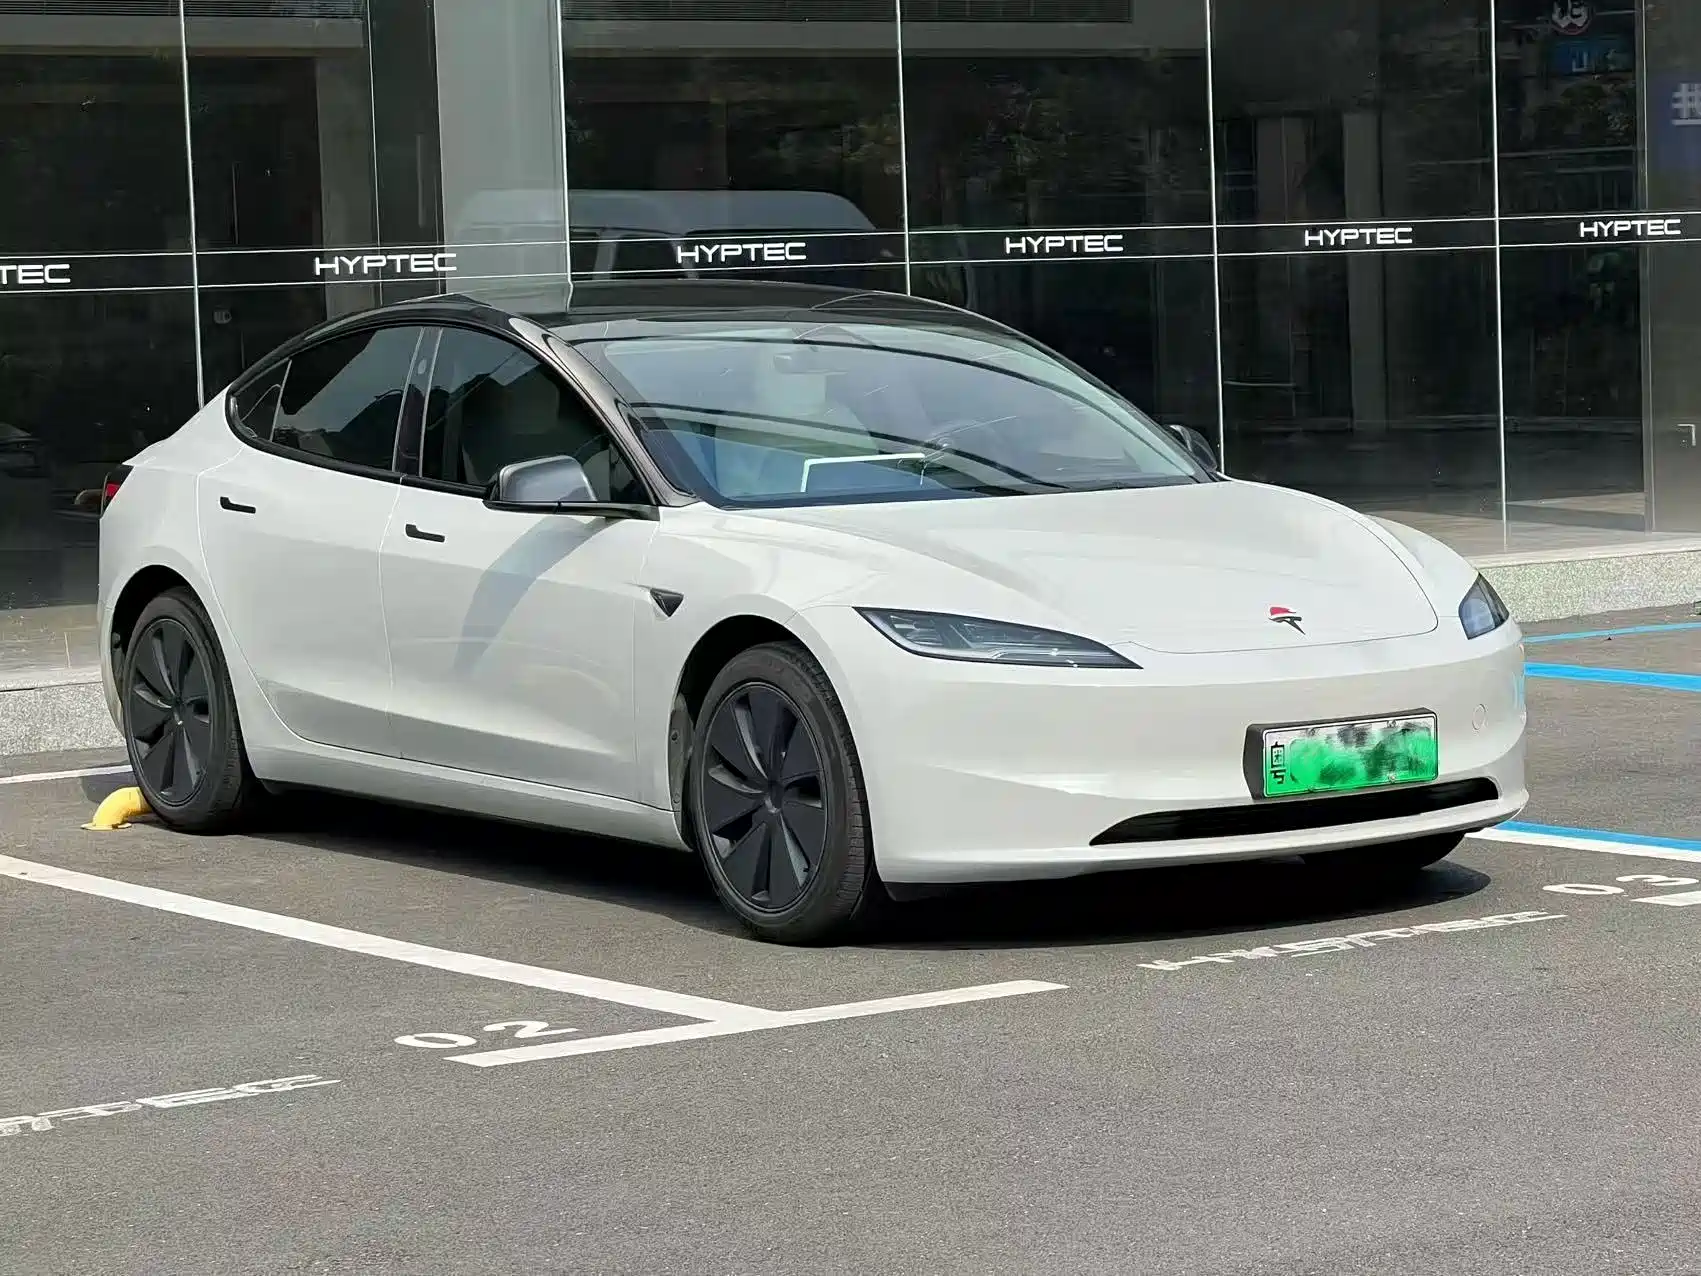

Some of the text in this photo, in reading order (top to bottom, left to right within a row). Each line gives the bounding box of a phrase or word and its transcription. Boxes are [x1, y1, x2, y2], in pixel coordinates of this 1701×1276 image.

[1304, 227, 1414, 247] HYPTEC
[1579, 218, 1682, 238] HYPTEC
[676, 242, 807, 264] HYPTEC
[1005, 234, 1124, 254] HYPTEC
[314, 253, 458, 276] HYPTEC
